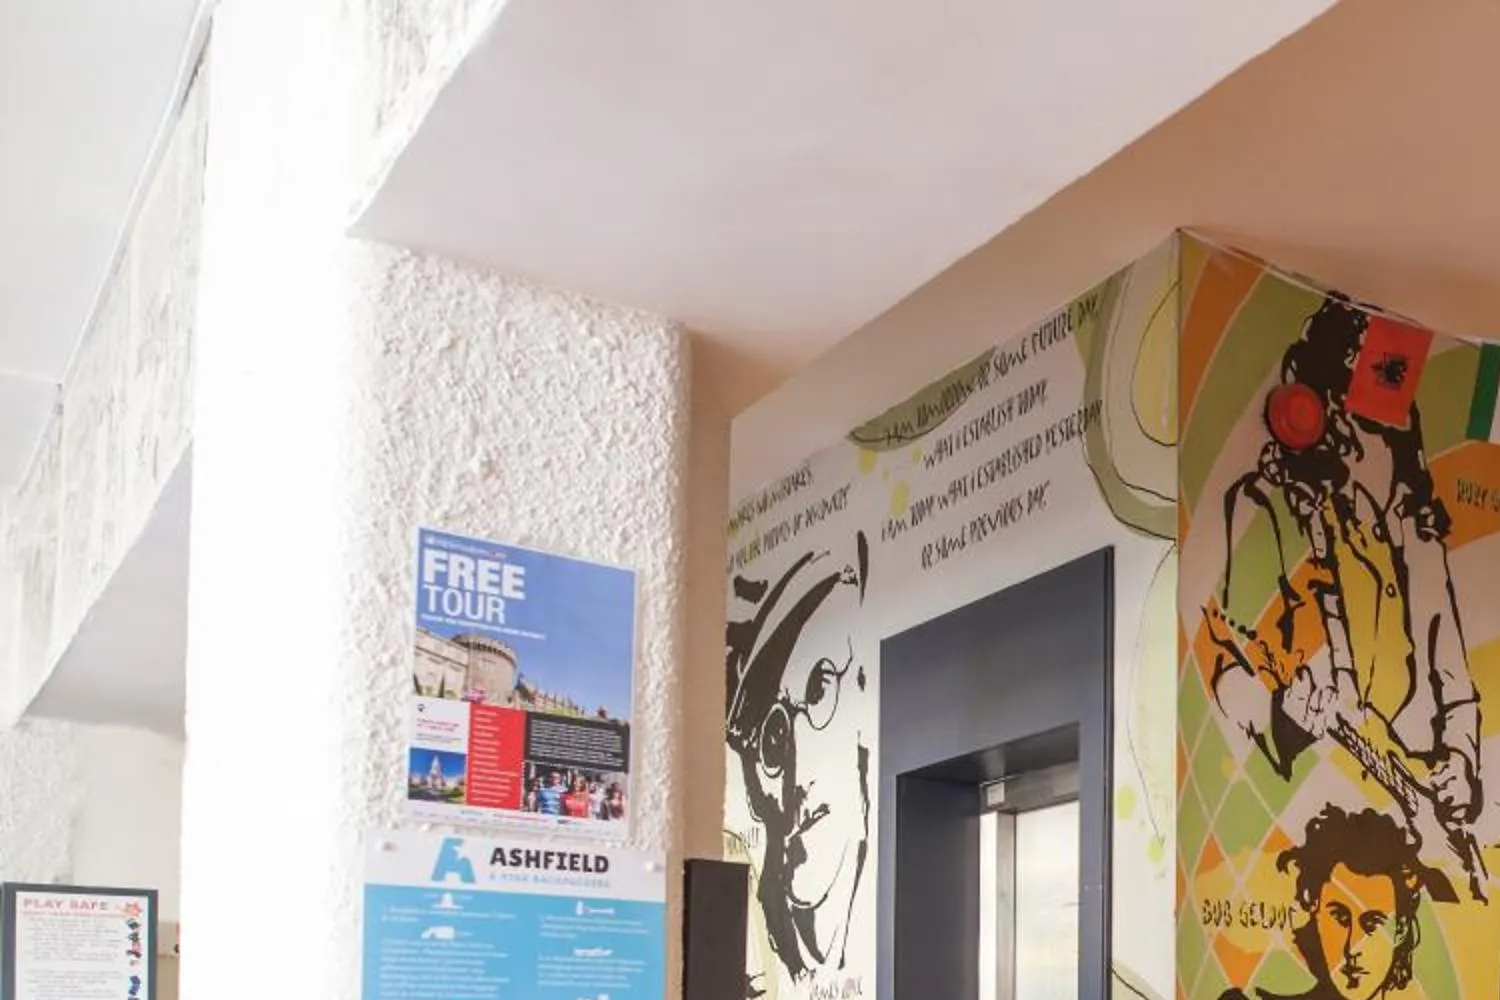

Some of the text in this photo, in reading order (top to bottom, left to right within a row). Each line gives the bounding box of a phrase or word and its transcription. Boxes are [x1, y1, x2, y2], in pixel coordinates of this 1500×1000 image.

[423, 548, 526, 600] FREE
[422, 584, 506, 625] TOUR
[489, 847, 609, 874] ASHFIELD
[1202, 899, 1233, 928] BOB
